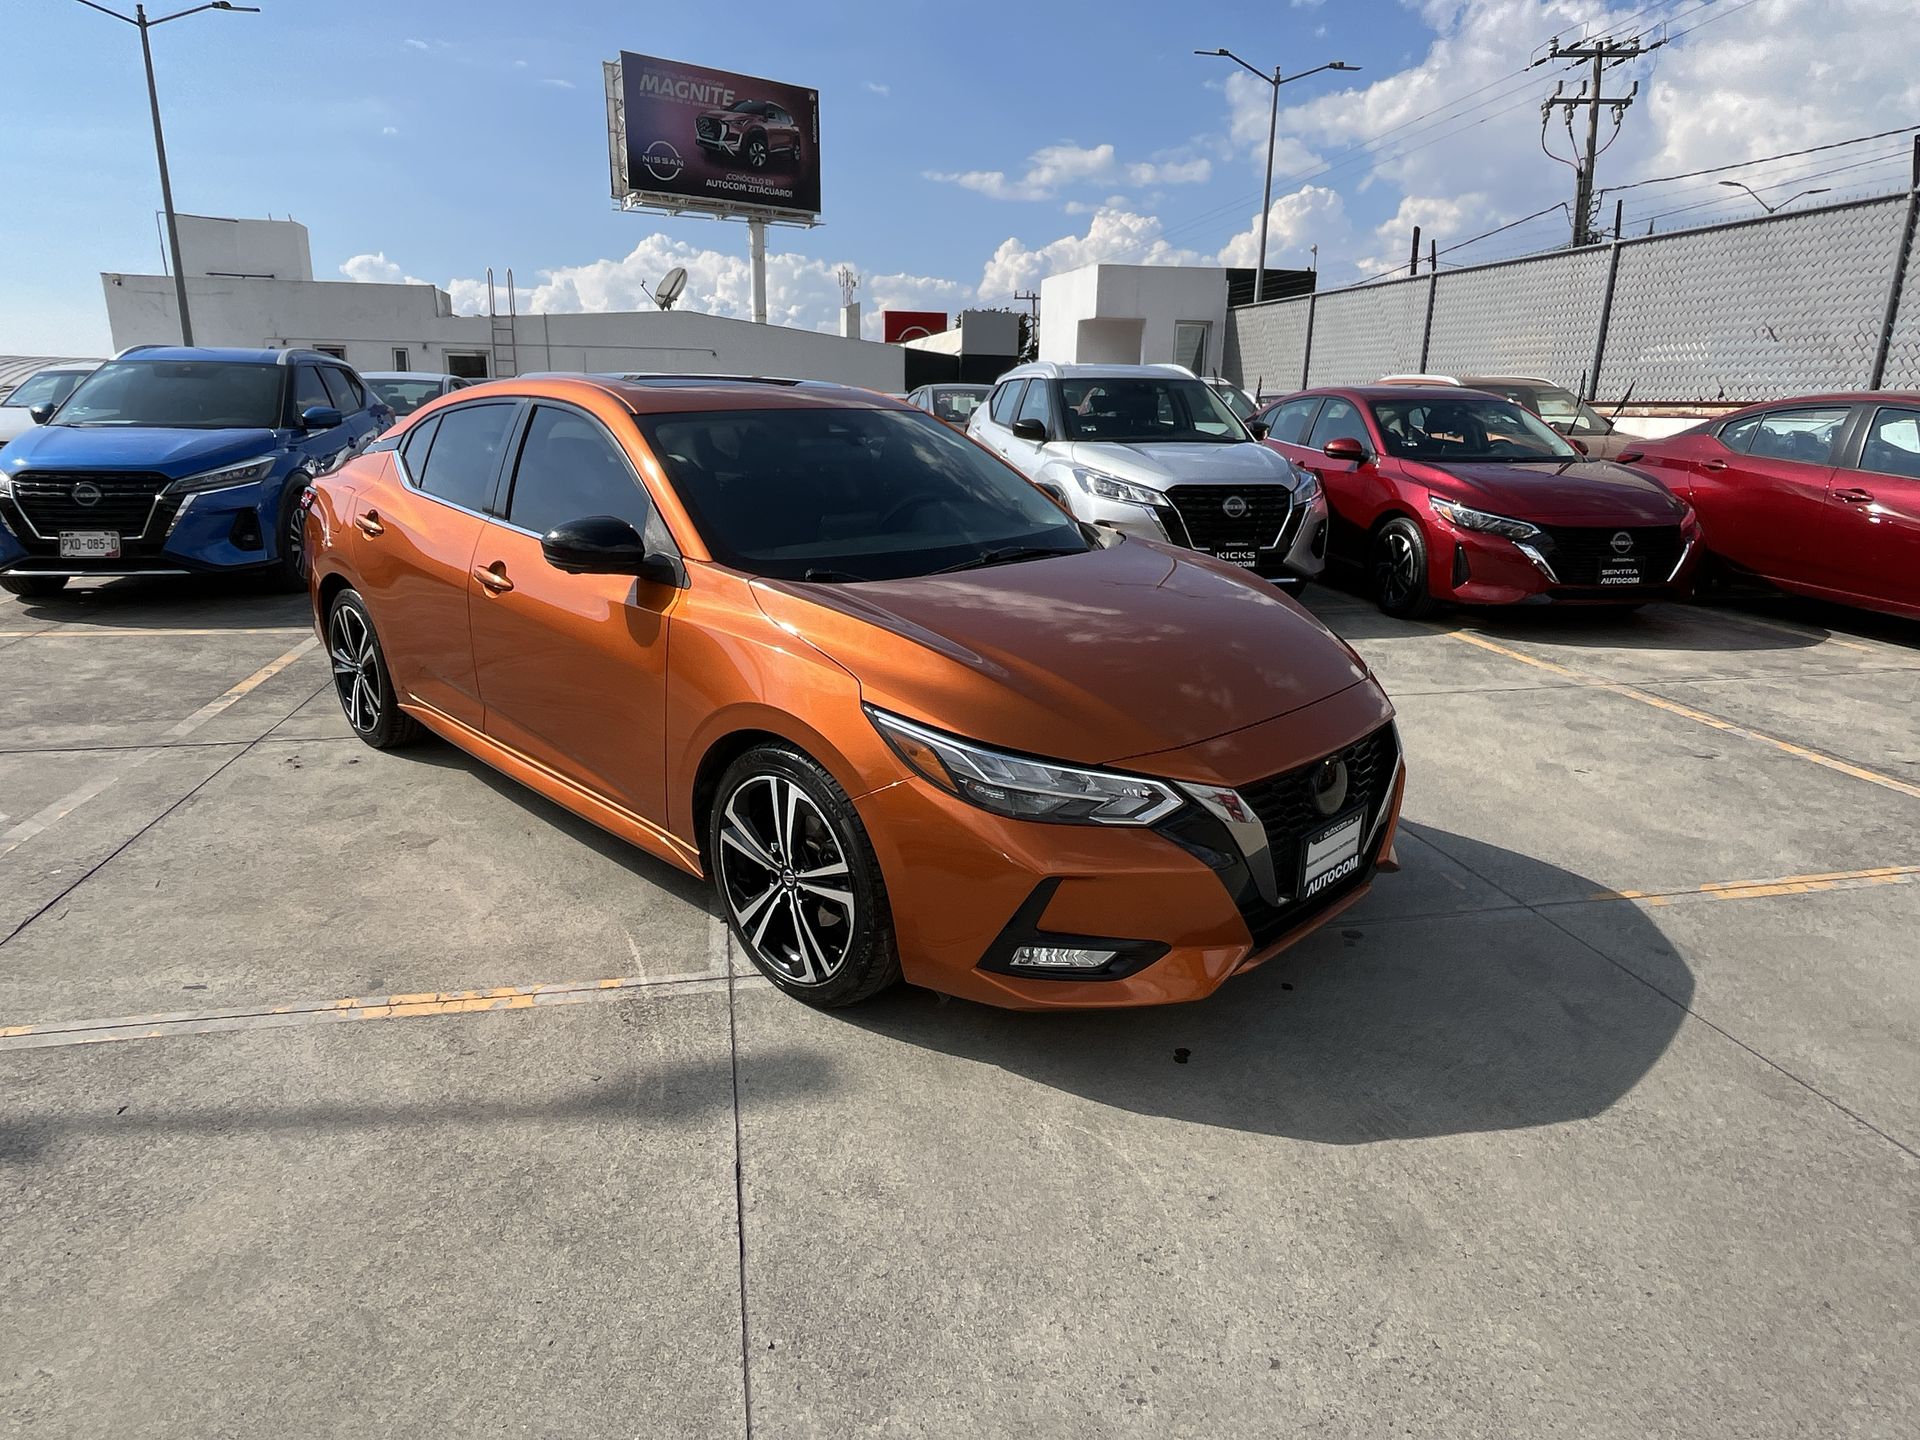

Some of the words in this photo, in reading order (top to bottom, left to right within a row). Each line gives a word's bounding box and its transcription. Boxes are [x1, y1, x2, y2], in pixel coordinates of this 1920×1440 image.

[640, 74, 736, 106] MAGNITE
[642, 155, 684, 167] NISSAN
[705, 179, 747, 192] AUTOCOM
[765, 178, 774, 186] EN
[1216, 551, 1256, 559] KICKS
[1601, 568, 1639, 576] SENTRA
[1600, 577, 1640, 585] AUTOCOM
[1306, 854, 1359, 898] AUTOCOM
